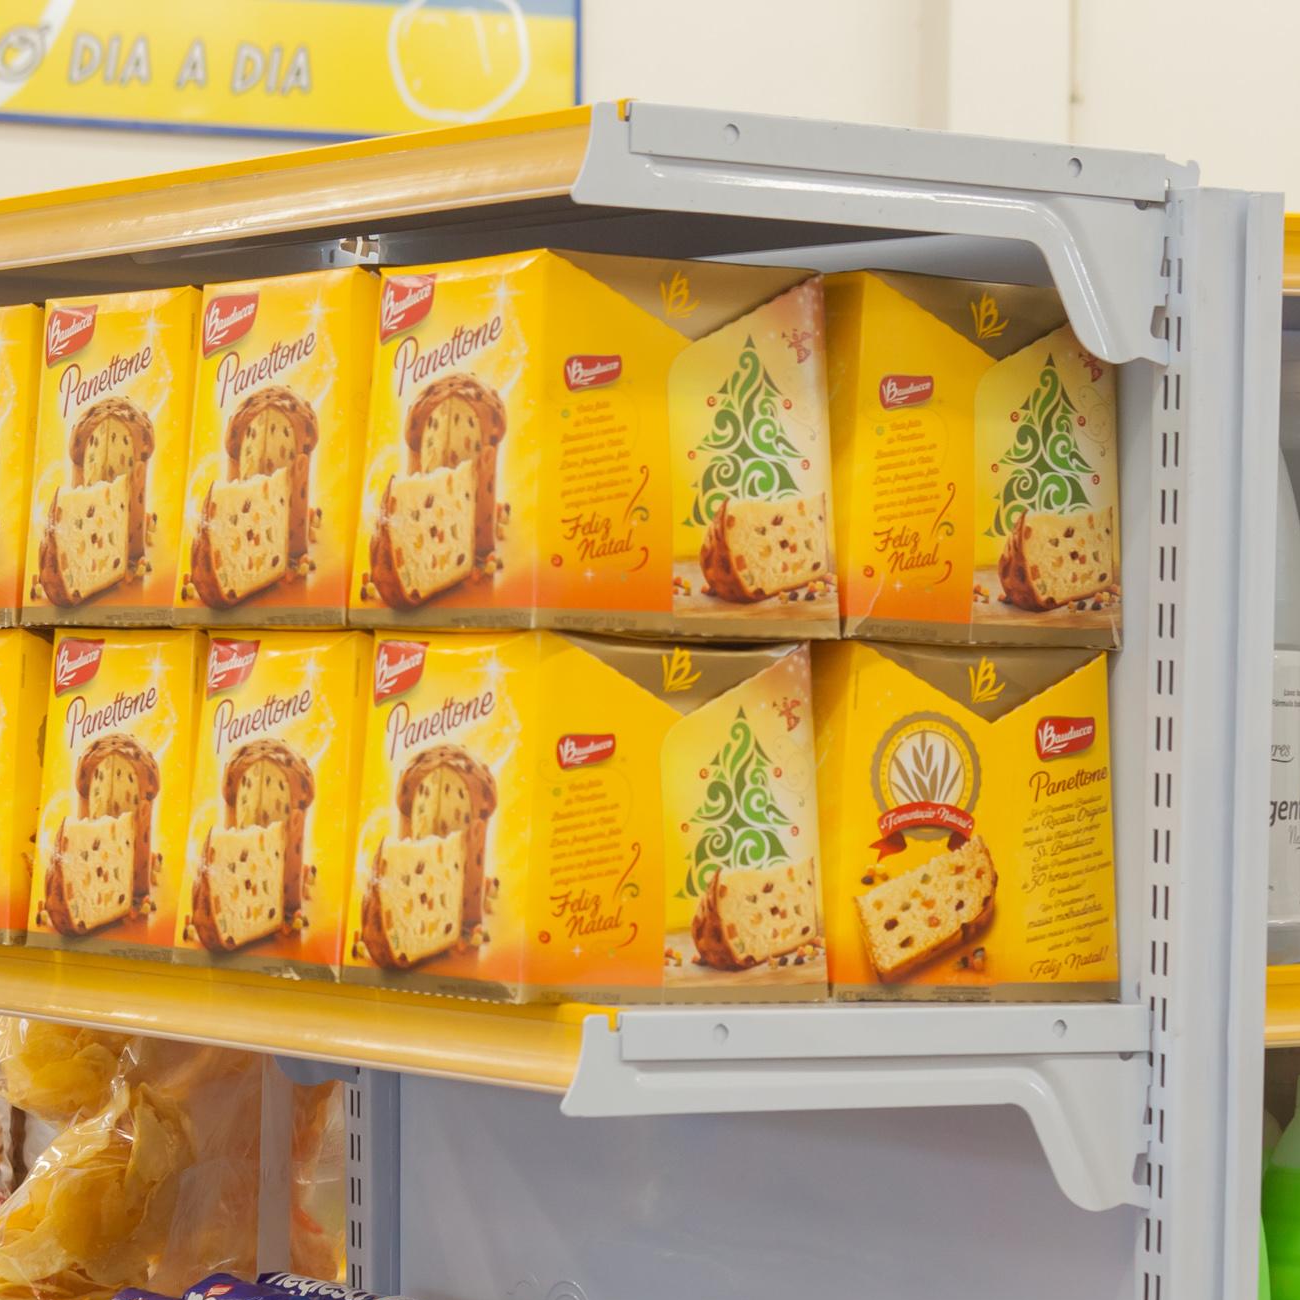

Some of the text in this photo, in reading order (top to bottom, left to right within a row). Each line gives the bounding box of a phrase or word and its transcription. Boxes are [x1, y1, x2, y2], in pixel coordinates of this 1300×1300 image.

[67, 33, 151, 86] DIA
[175, 38, 208, 90] A
[231, 44, 314, 96] DIA
[204, 299, 256, 346] Bauducco
[383, 282, 433, 331] Bauducco
[49, 314, 95, 356] Bauducco
[217, 331, 317, 408] Panettone
[393, 315, 504, 398] Panettone
[566, 358, 621, 386] Bauducco
[59, 343, 153, 418] Panettone
[881, 377, 933, 406] Bauducco
[562, 508, 612, 541] Feliz
[873, 526, 921, 554] Feliz
[577, 534, 635, 562] Natal
[887, 543, 940, 574] Natal
[57, 646, 100, 687] Bauducco
[208, 649, 256, 689] Bauducco
[376, 649, 424, 693] Bauducco
[66, 686, 158, 749] Panettone
[214, 688, 313, 753] Panettone
[386, 690, 496, 760] Panettone
[559, 737, 614, 765] Bauducco
[1038, 721, 1094, 754] Bauducco
[1029, 766, 1109, 802] Panettone
[937, 805, 971, 831] Natural
[550, 889, 602, 920] Feliz
[565, 908, 624, 939] Natal
[1029, 960, 1063, 981] Feliz
